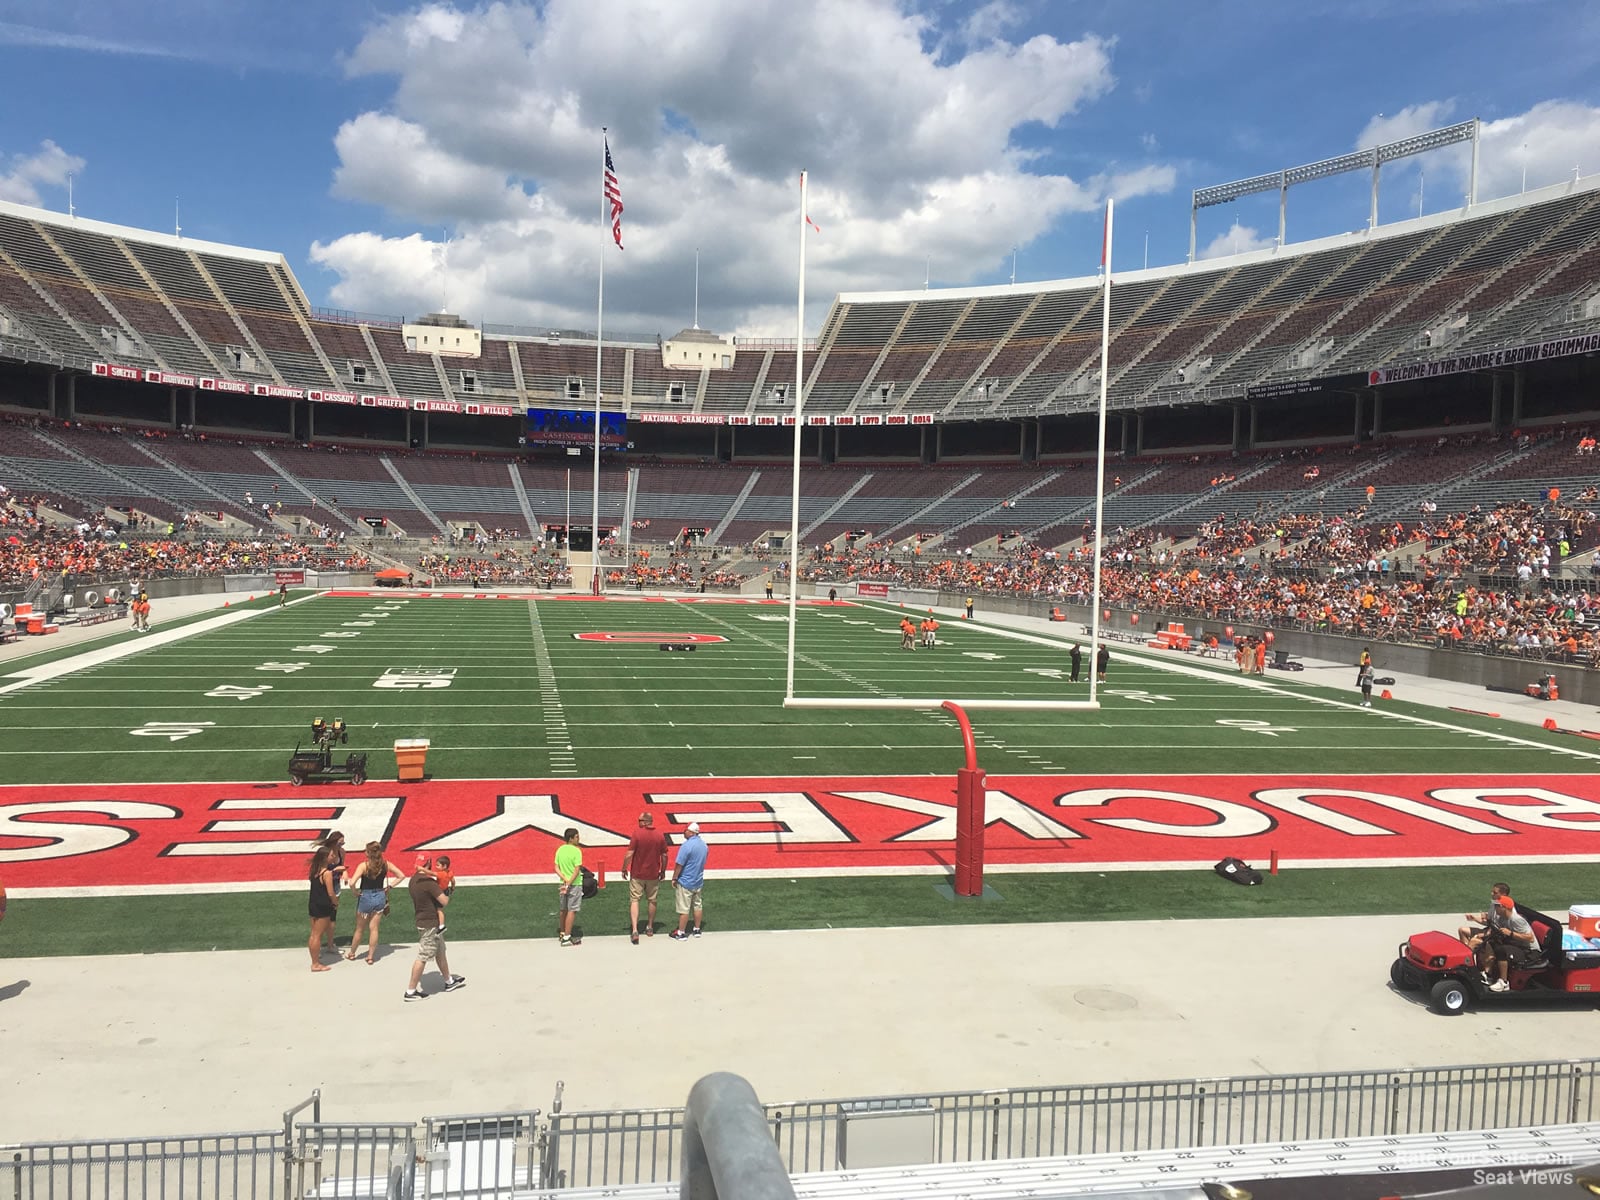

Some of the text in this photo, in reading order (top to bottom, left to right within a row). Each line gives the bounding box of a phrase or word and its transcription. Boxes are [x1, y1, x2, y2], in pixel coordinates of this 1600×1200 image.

[1385, 364, 1426, 382] WELCOME
[1427, 363, 1438, 374] TO
[1440, 360, 1457, 373] THE
[1458, 354, 1494, 372] ORANGE
[1504, 347, 1539, 365] BROWN
[217, 381, 247, 392] GEORGE
[324, 393, 355, 404] CASSADY
[377, 398, 407, 408] GRIFFIN
[430, 403, 459, 412] HARLEY
[482, 406, 509, 415] WILLIS
[643, 414, 723, 424] NATIONAL CHAMPIONS
[543, 432, 576, 440] CASTING
[0, 787, 1600, 863] BUCKEYES
